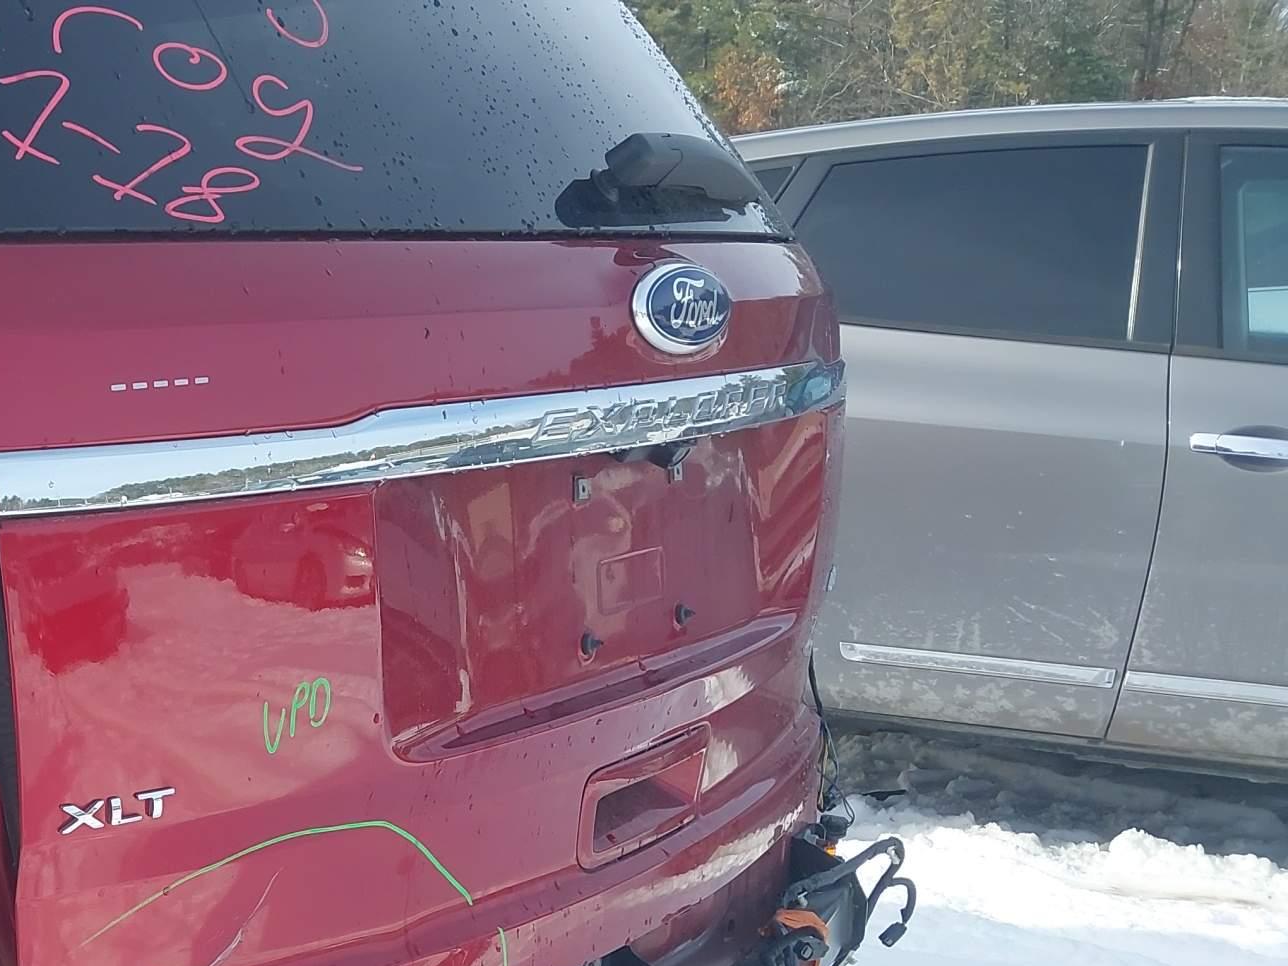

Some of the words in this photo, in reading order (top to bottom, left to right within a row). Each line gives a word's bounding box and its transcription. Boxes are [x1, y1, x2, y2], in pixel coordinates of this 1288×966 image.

[670, 276, 728, 330] Ford
[532, 380, 788, 446] EXPLORER
[59, 786, 176, 835] XLT
